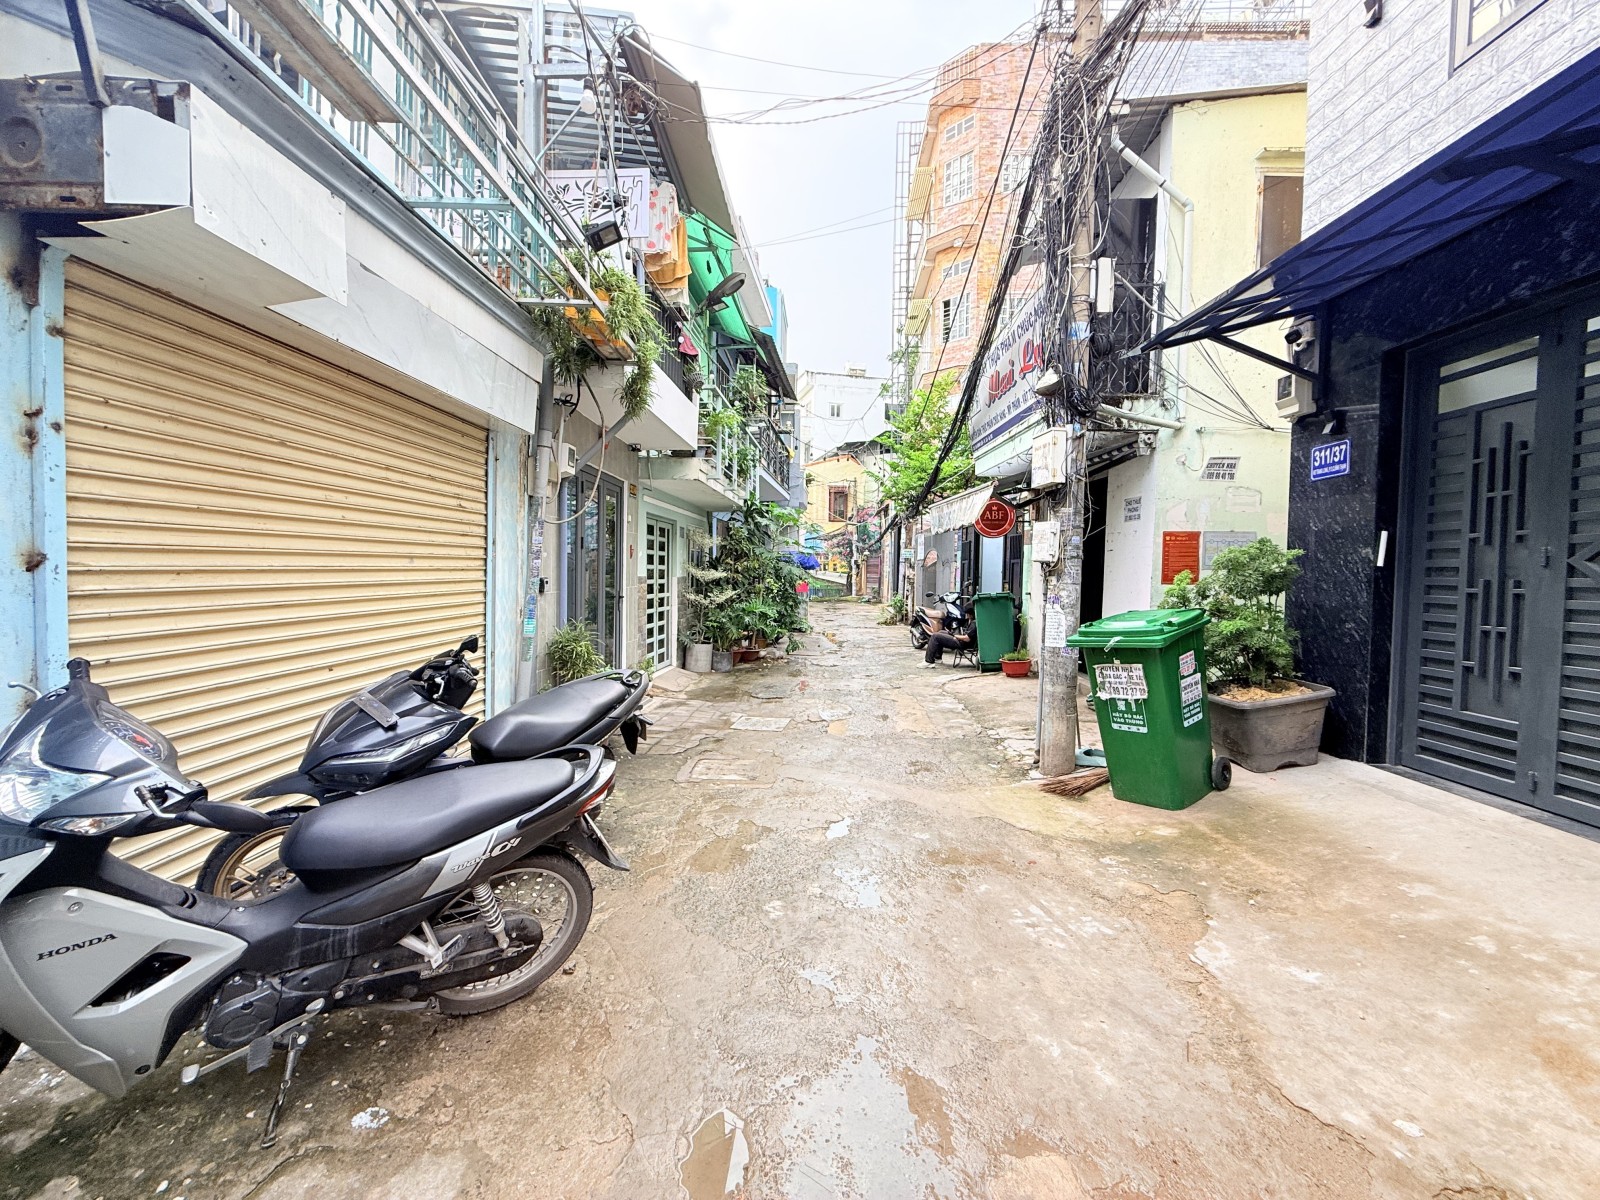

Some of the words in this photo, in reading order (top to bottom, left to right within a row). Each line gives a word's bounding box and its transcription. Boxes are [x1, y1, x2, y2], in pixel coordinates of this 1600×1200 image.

[1314, 444, 1347, 467] 311/37
[983, 510, 1005, 520] ABF
[36, 933, 118, 962] HONDA
